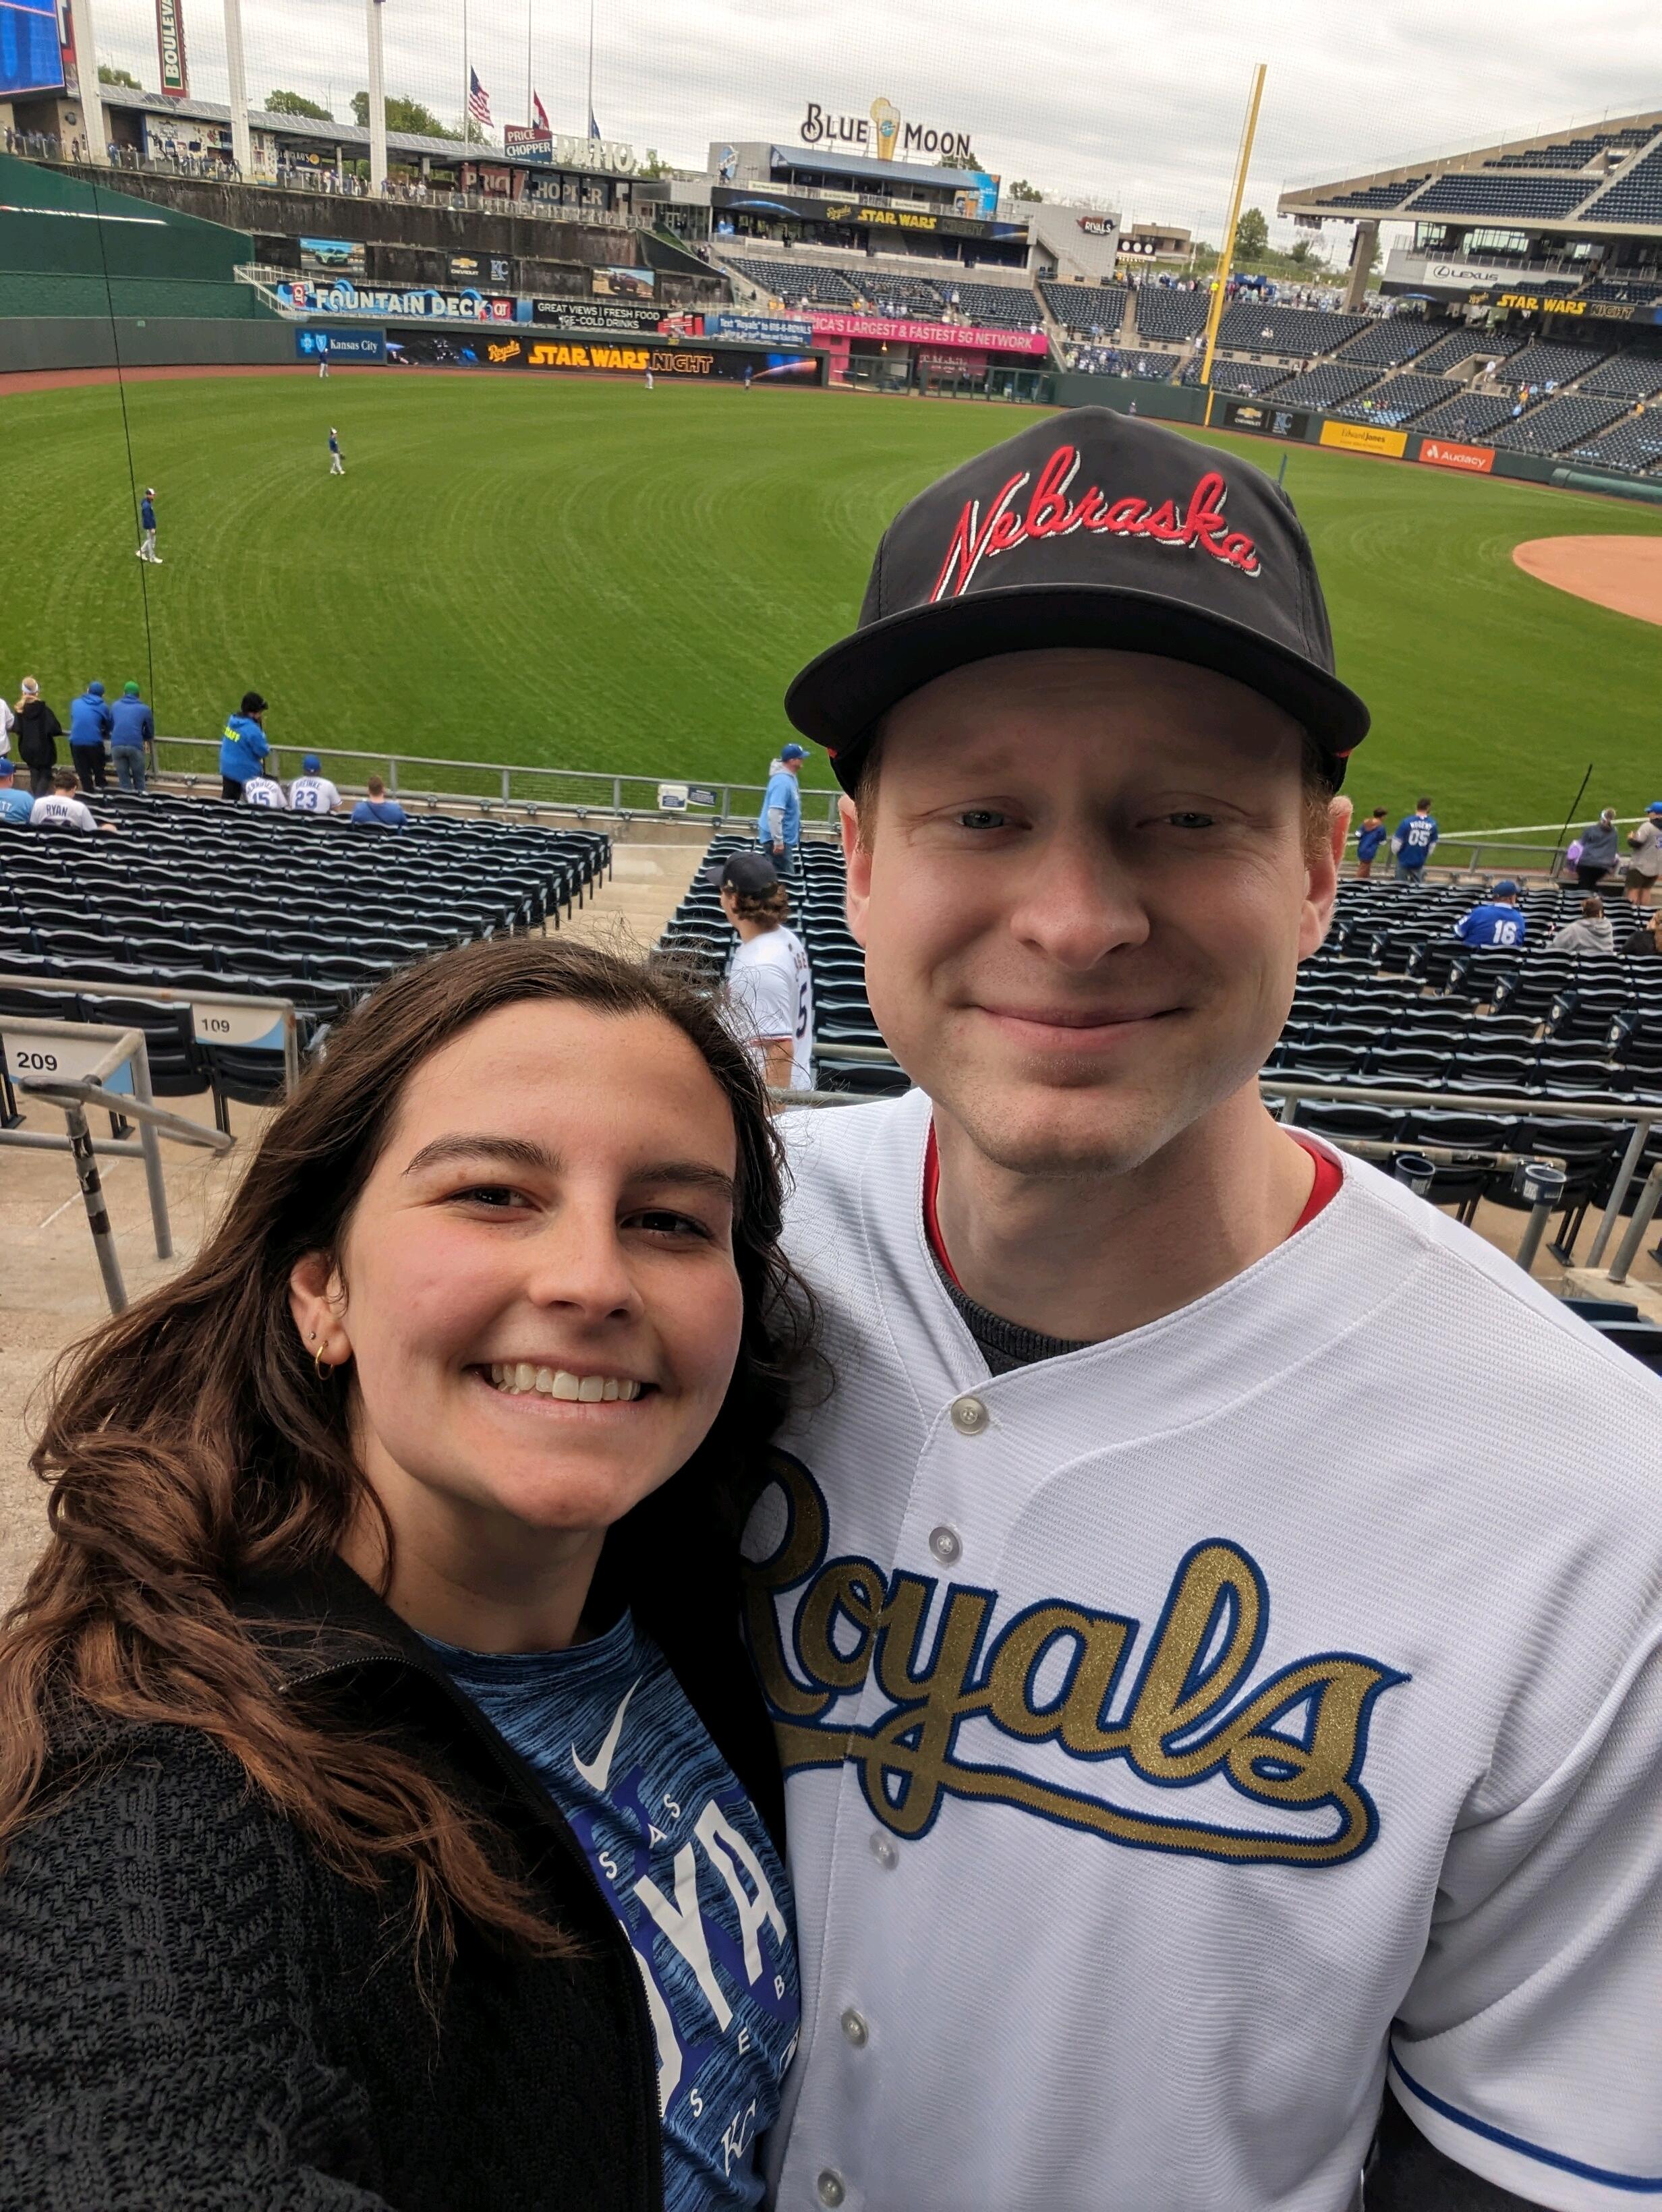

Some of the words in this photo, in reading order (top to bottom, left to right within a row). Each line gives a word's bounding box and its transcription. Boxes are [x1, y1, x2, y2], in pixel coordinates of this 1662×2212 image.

[507, 129, 536, 143] PRICE
[801, 103, 869, 143] BLUE
[905, 123, 971, 158] MOON
[507, 142, 551, 158] CHOPPER
[857, 209, 897, 225] STAR
[900, 214, 938, 230] WARS
[1085, 221, 1112, 233] RIVALS
[1450, 271, 1499, 282] LEXUS
[316, 289, 425, 314] FOUNTAIN
[432, 298, 488, 317] DECK
[538, 303, 567, 314] GREAT
[569, 305, 598, 316] VIEWS
[604, 308, 633, 318] FRESH
[635, 310, 660, 321] FOOD
[1497, 294, 1539, 310] STAR
[1543, 299, 1586, 315] WARS
[1591, 303, 1635, 320] NIGHT
[606, 318, 640, 329] DRINKS
[847, 320, 898, 336] LARGEST
[899, 324, 907, 338] &
[909, 326, 957, 343] FASTEST
[958, 331, 974, 344] 5G
[975, 334, 1032, 349] NETWORK
[330, 338, 359, 351] Kansas
[361, 339, 378, 353] City
[488, 340, 521, 362] Royals
[529, 345, 590, 367] STAR
[590, 347, 650, 370] WARS
[652, 351, 714, 373] NIGHT
[1441, 450, 1486, 468] Audacy
[929, 445, 1261, 603] Nebraska
[295, 790, 318, 809] 23
[46, 804, 68, 817] RYAN
[1408, 829, 1430, 847] 05
[1492, 919, 1517, 945] 16
[201, 1018, 231, 1034] 109
[16, 1051, 59, 1072] 209
[742, 1445, 1412, 1869] Royals
